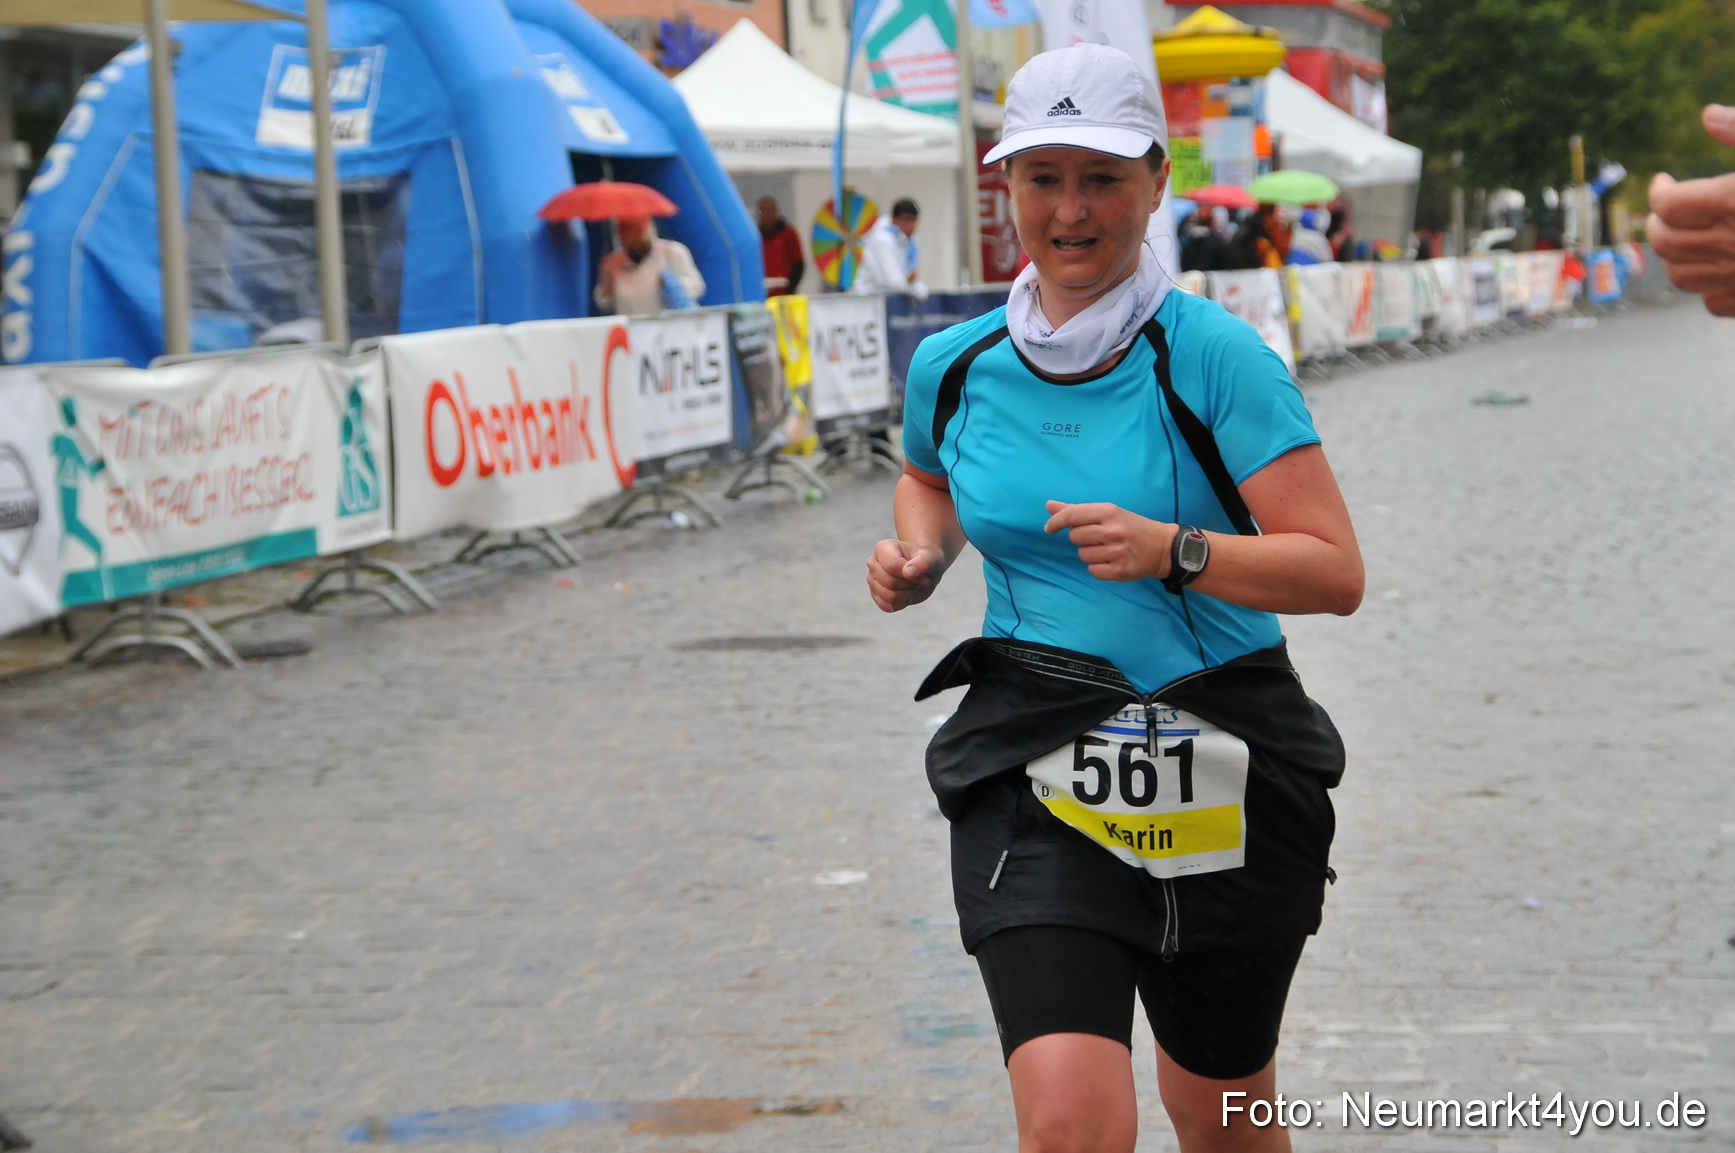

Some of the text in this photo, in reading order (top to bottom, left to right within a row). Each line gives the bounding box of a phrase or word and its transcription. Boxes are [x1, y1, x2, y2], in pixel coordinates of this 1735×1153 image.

[1046, 107, 1082, 117] adidas
[424, 359, 598, 489] Oberbank
[1042, 422, 1082, 433] GORE
[1071, 735, 1195, 808] 561
[1102, 819, 1174, 851] Karin
